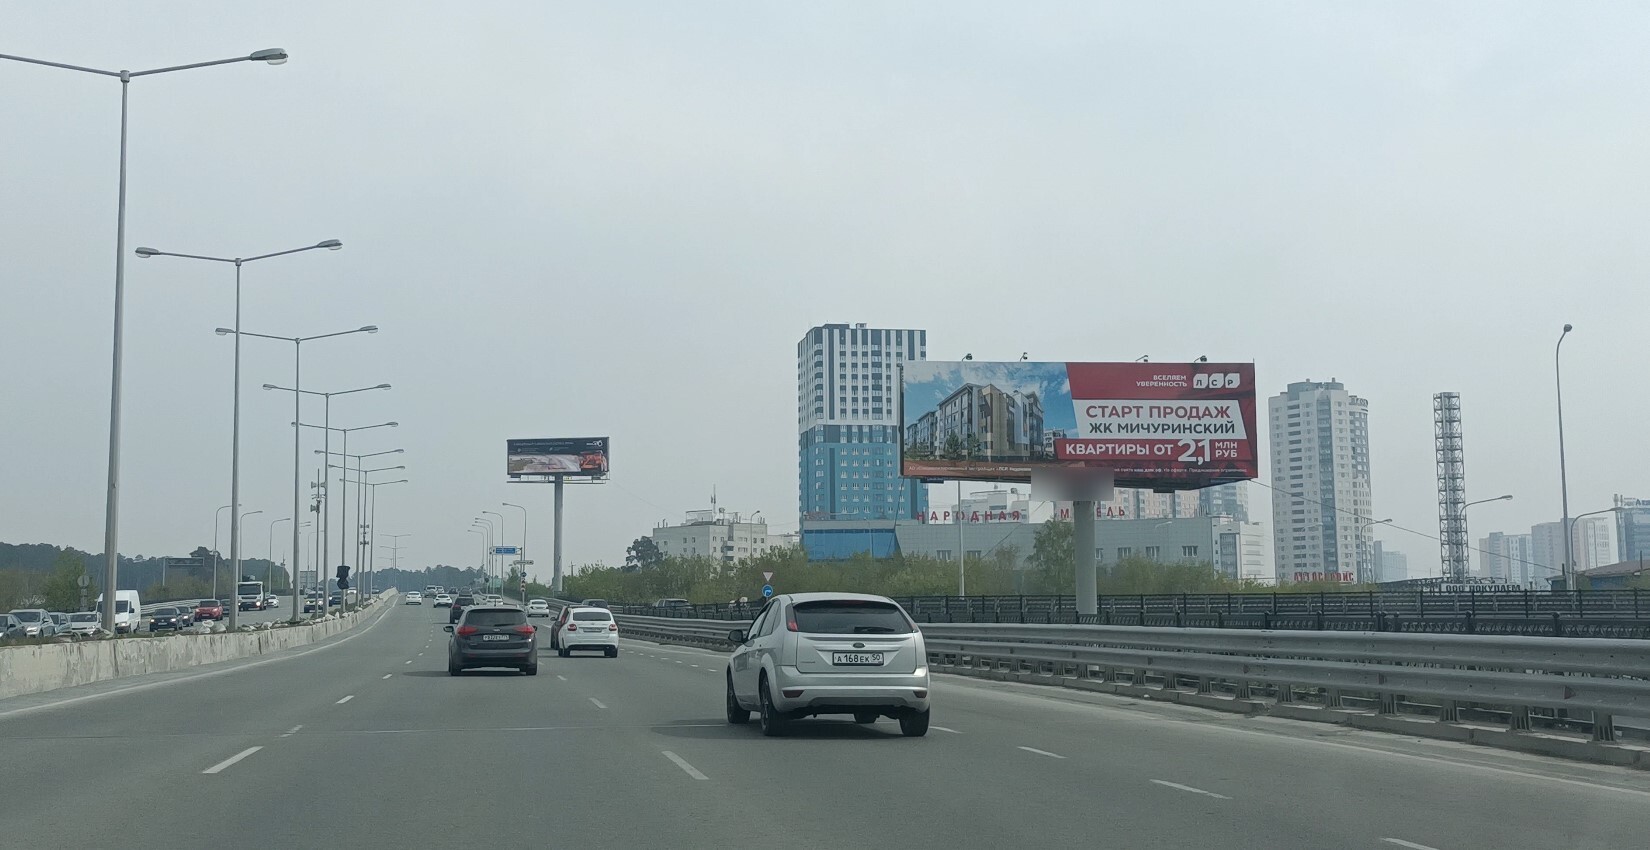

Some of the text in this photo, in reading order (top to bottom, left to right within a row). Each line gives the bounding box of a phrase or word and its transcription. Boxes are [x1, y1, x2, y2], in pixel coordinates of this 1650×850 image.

[1136, 380, 1188, 388] УВЕРЕННОСТЬ
[1194, 376, 1238, 388] ЛСР
[1085, 405, 1231, 421] СТАРТ ПРОДАЖ
[1089, 420, 1236, 434] ЖК МИЧУРИНСКИЙ
[1065, 438, 1211, 465] КВАРТИРЫ ОТ 2,1
[1215, 441, 1238, 449] МЛН
[1215, 449, 1238, 458] РУБ
[915, 506, 1126, 522] НАРОДНАЯ МЕЛЬ
